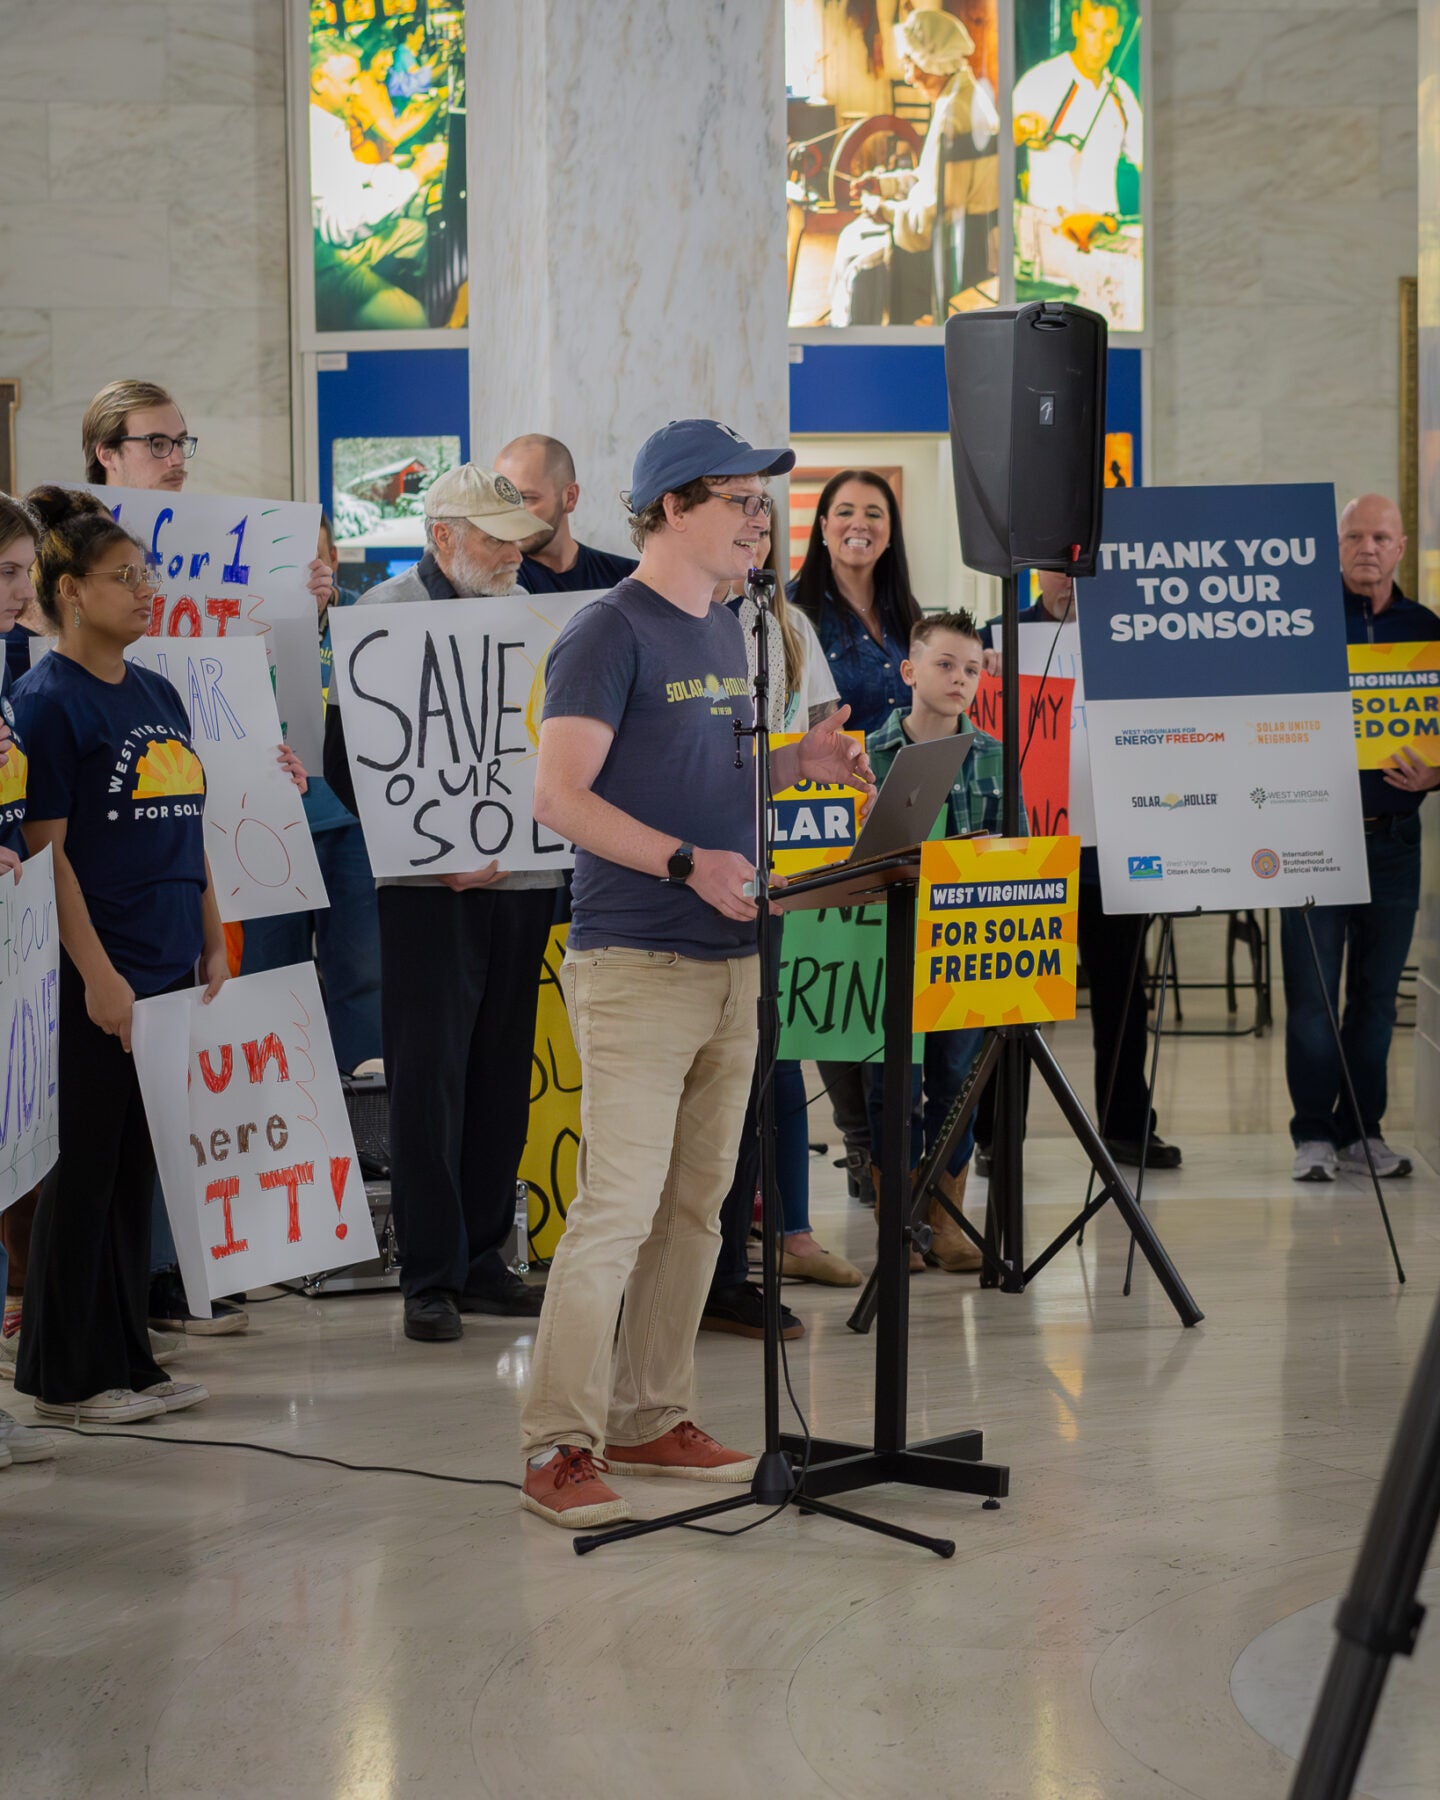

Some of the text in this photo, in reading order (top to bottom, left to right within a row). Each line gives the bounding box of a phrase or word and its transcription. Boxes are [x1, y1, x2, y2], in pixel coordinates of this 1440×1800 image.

[221, 515, 250, 585] 1
[1099, 538, 1316, 570] THANK YOU
[1137, 575, 1281, 605] TO OUR
[1110, 609, 1314, 642] SPONSORS
[349, 630, 527, 772] SAVE
[665, 679, 705, 703] SOLAR
[1028, 693, 1063, 740] MY
[1352, 696, 1438, 714] SOLAR
[1115, 732, 1225, 745] ENERGY FREEDOM
[1256, 720, 1321, 732] SOLAR UNITED
[1257, 733, 1310, 744] NEIGHBORS
[108, 740, 136, 793] WEST
[1131, 793, 1217, 807] SOLAR HOLLER
[1268, 790, 1329, 799] WEST VIRGINIA
[134, 806, 168, 820] FOR
[409, 799, 577, 866] SOL
[1282, 850, 1324, 858] International
[1283, 858, 1324, 866] Brotherhood
[933, 882, 1064, 905] WEST VIRGINIANS
[931, 917, 1062, 947] FOR SOLAR
[930, 949, 1061, 984] FREEDOM
[204, 1156, 351, 1260] IT!
